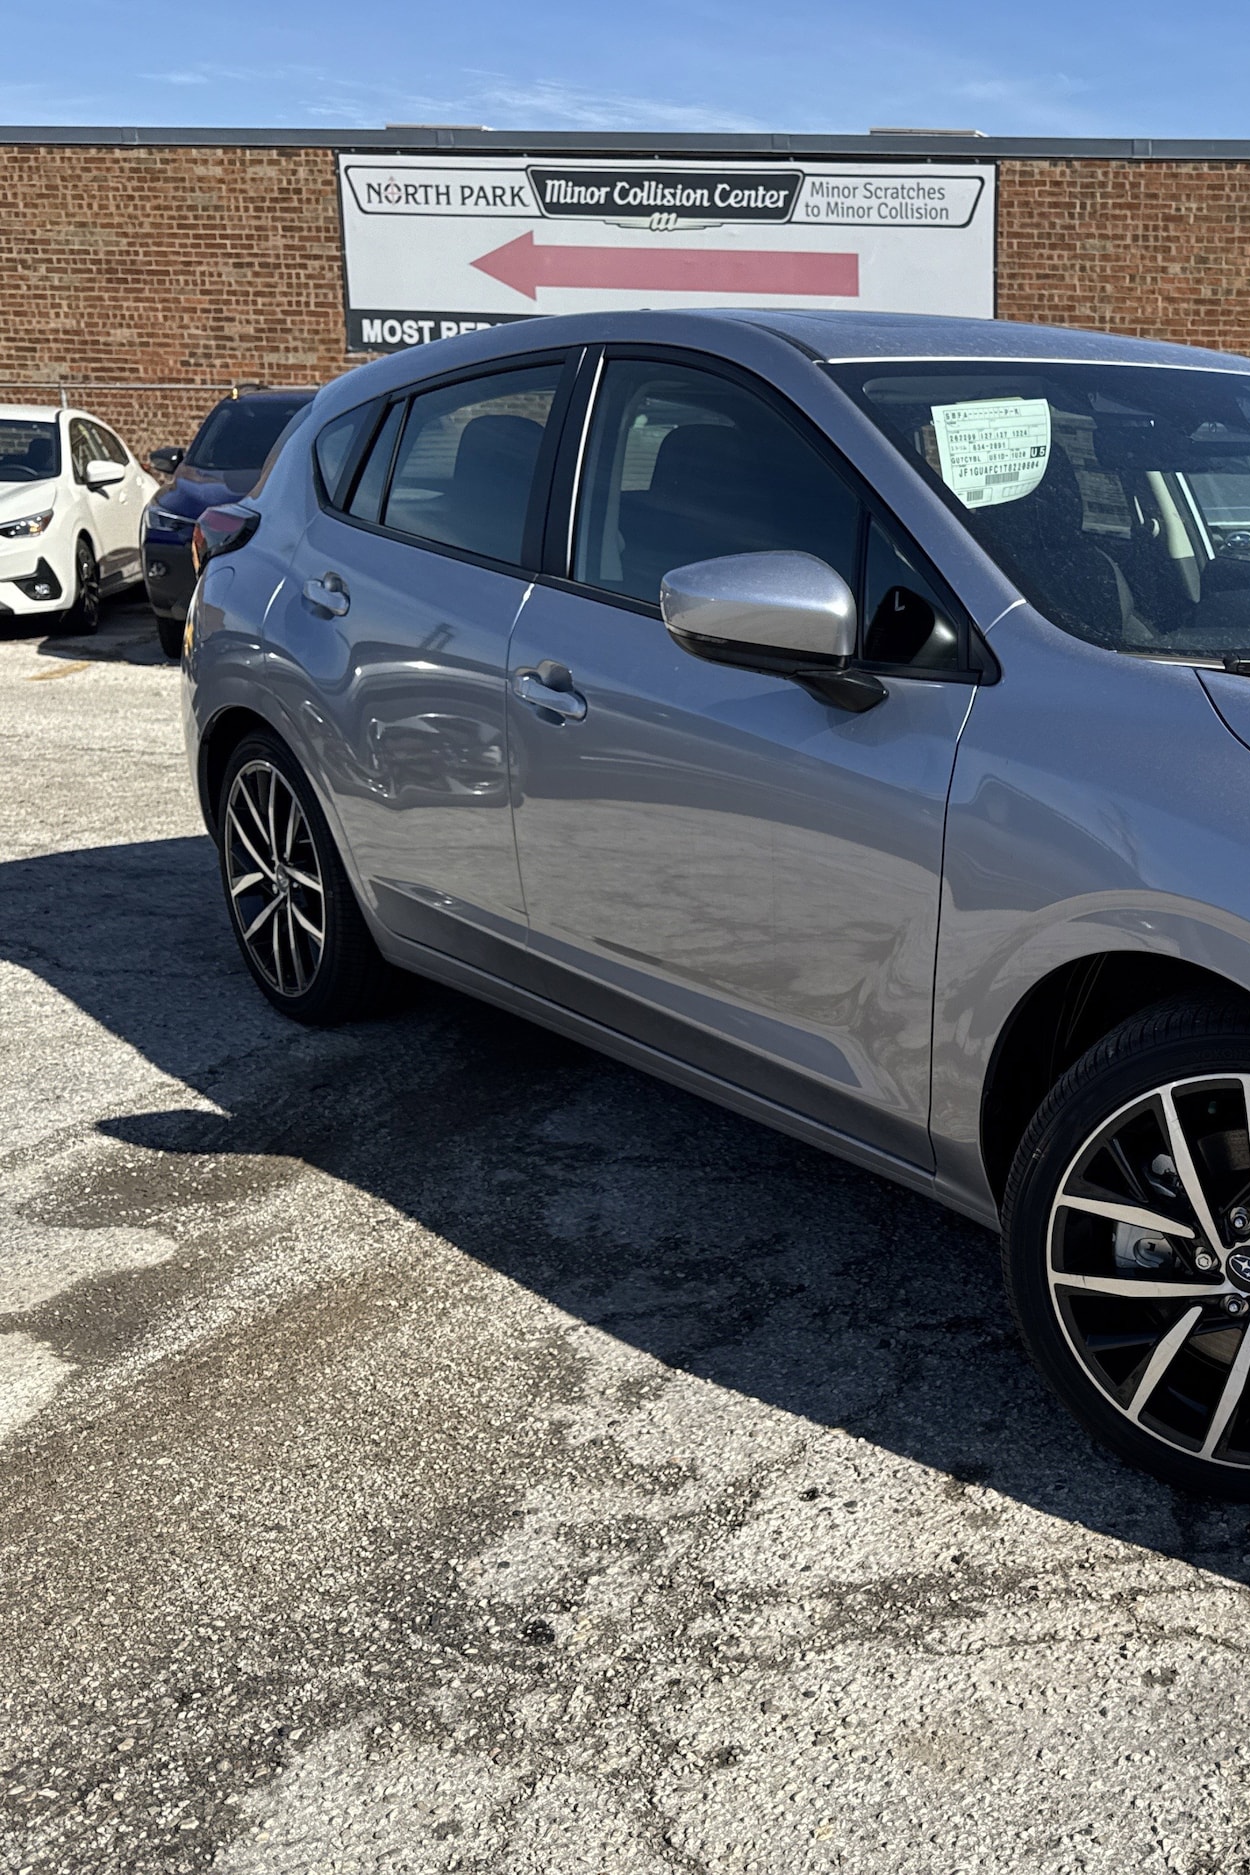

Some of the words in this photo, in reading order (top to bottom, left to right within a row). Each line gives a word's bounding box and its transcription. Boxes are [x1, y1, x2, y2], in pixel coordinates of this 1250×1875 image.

[366, 181, 451, 206] NORTH
[460, 185, 531, 208] PARK
[545, 179, 610, 205] Minor
[613, 180, 711, 207] Collision
[714, 183, 789, 209] Center
[810, 181, 859, 199] Minor
[863, 181, 946, 200] Scratches
[805, 202, 821, 218] to
[825, 201, 873, 219] Minor
[877, 202, 949, 221] Collision
[361, 318, 435, 345] MOST
